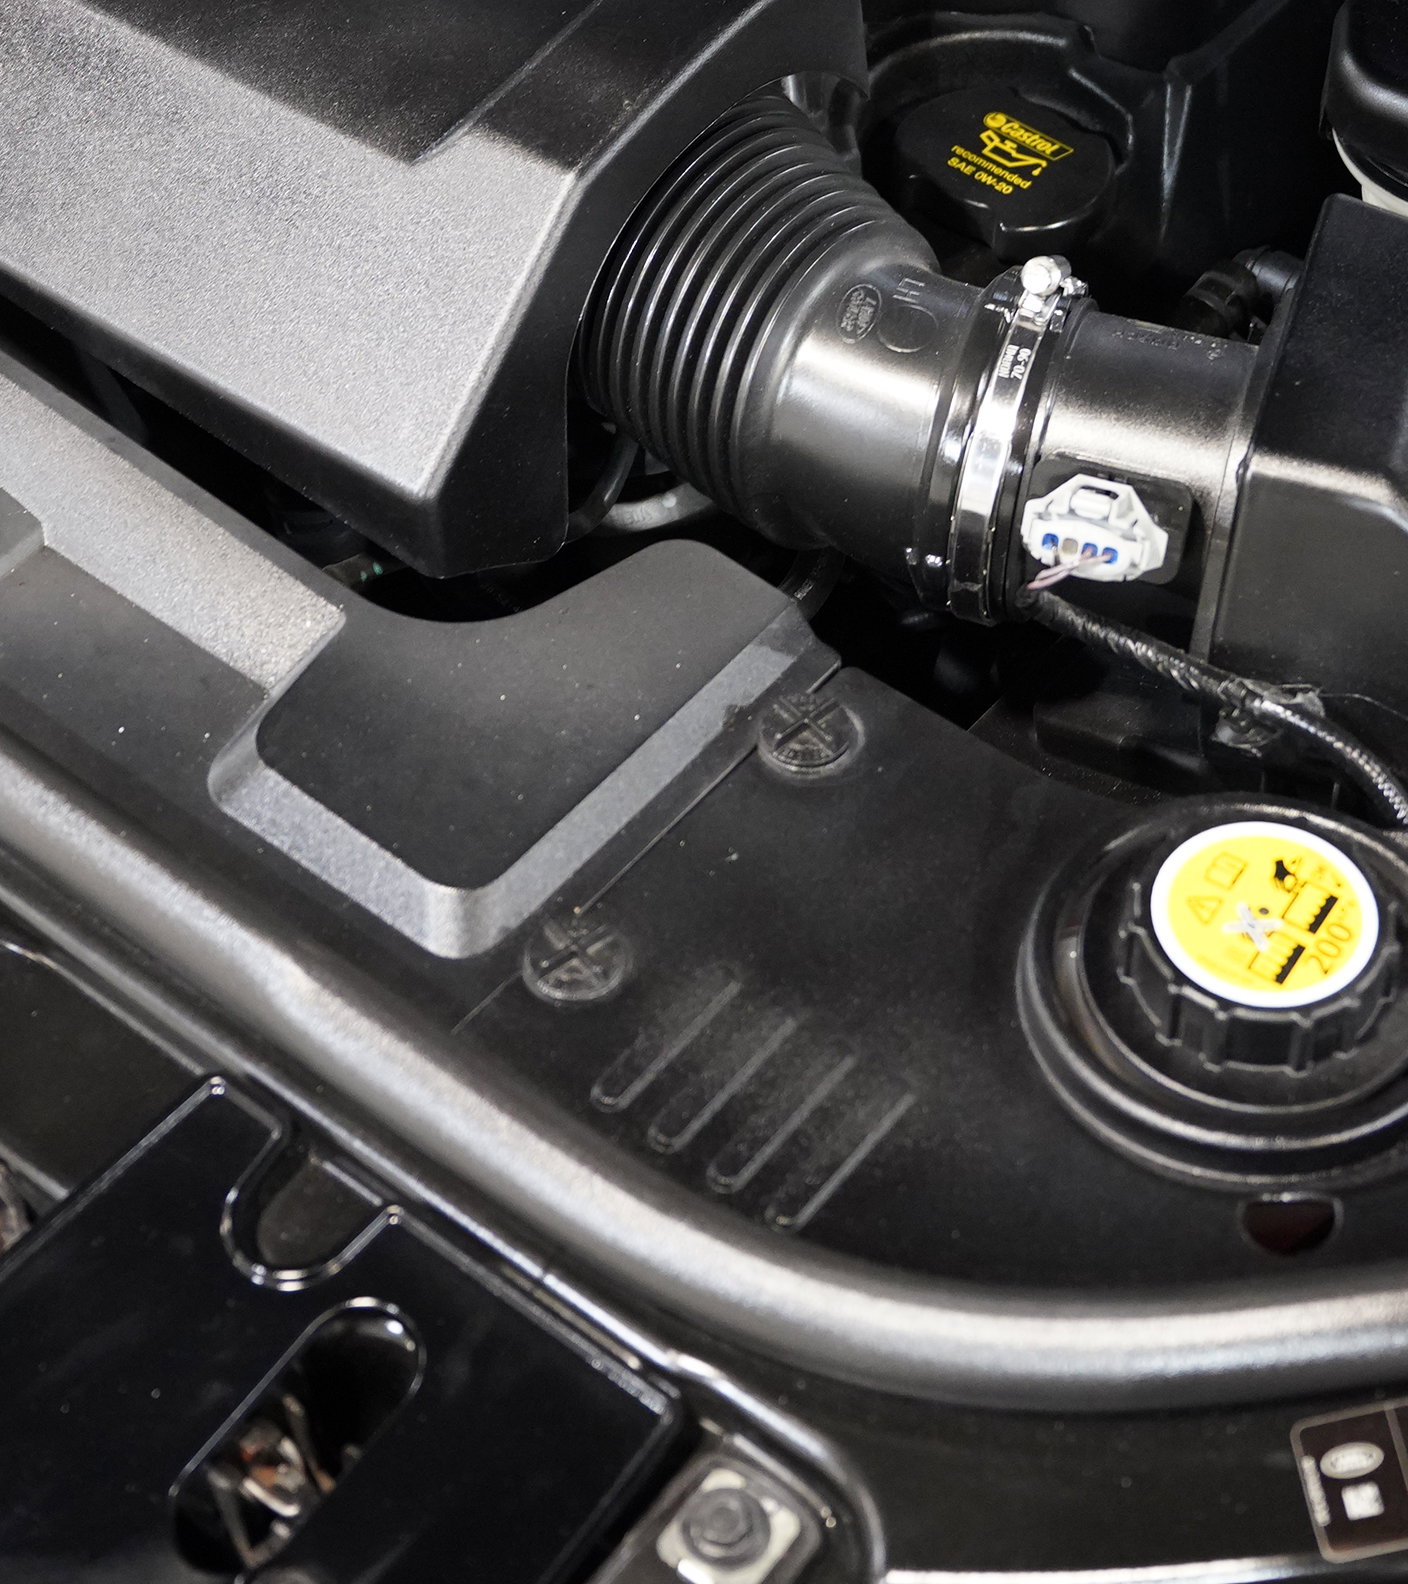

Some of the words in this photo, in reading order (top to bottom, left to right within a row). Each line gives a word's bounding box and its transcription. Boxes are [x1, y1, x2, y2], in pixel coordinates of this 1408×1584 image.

[1000, 121, 1060, 155] Castrol
[947, 157, 976, 176] SAE
[973, 171, 1013, 194] 0W-20
[950, 144, 1032, 189] recommended
[1010, 347, 1032, 380] 70-90
[1305, 922, 1353, 976] 200
